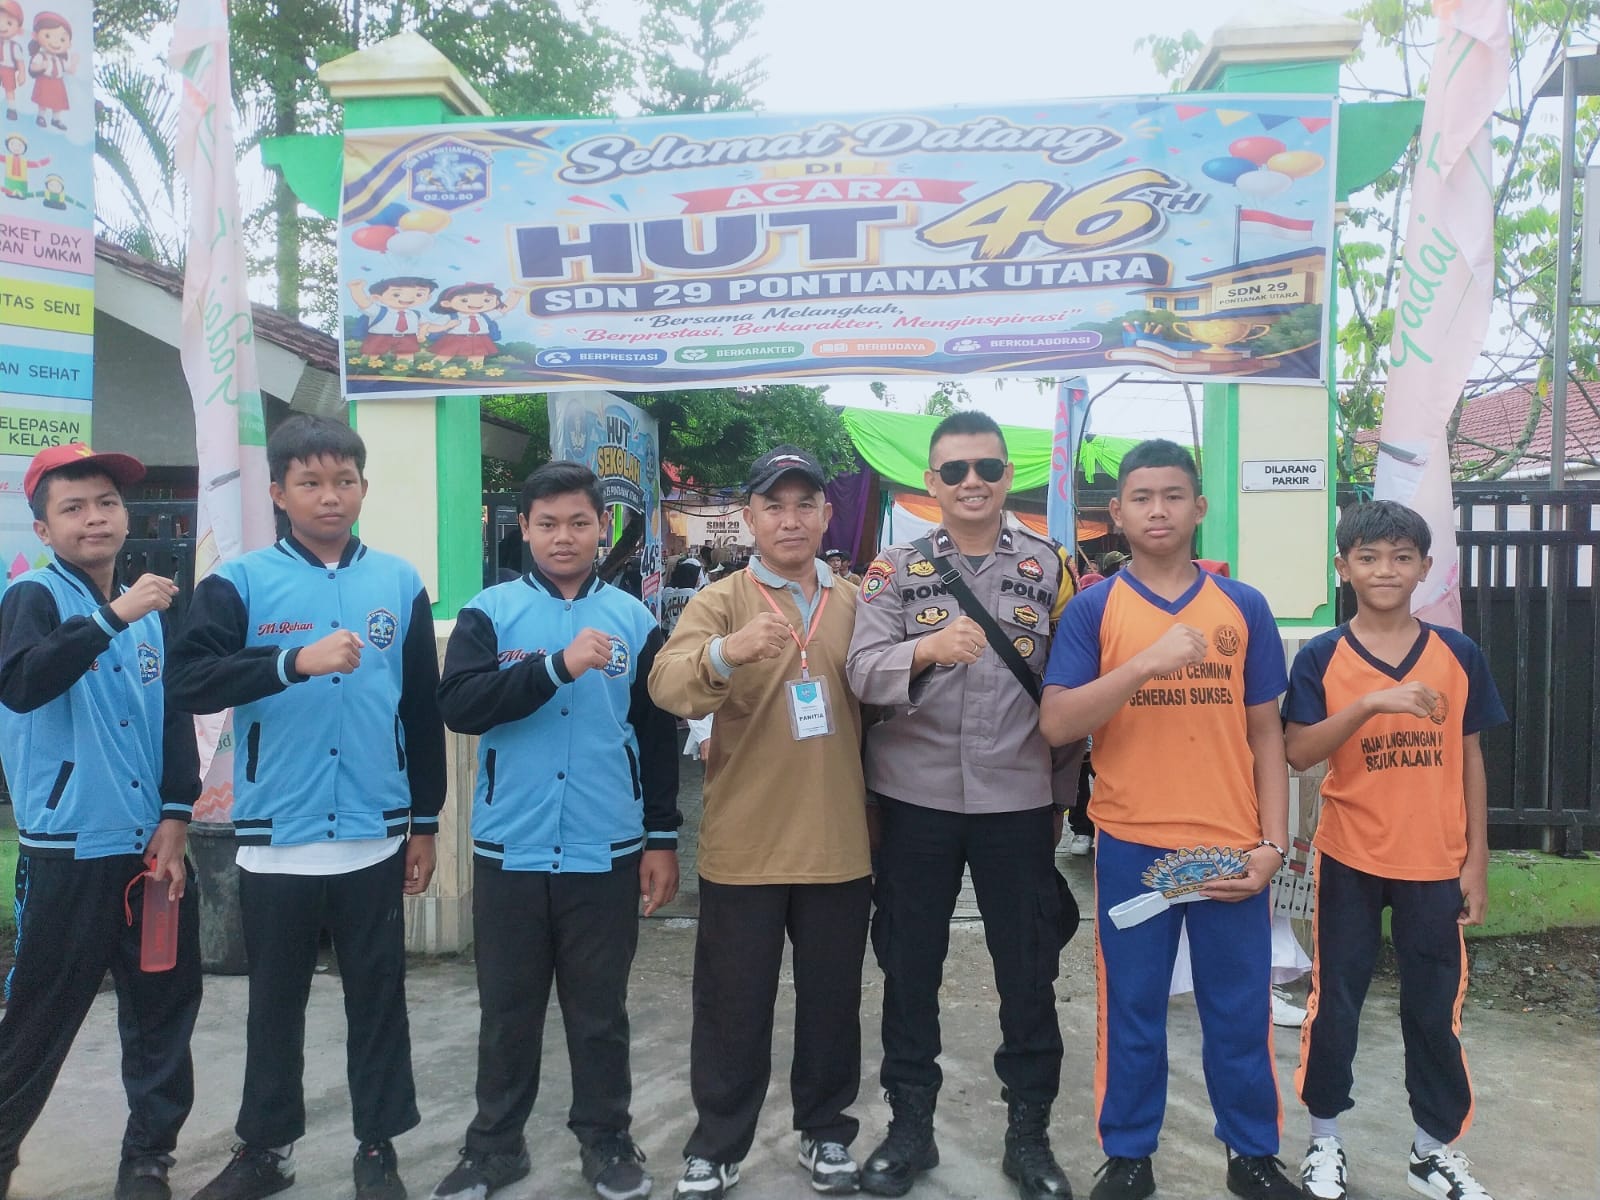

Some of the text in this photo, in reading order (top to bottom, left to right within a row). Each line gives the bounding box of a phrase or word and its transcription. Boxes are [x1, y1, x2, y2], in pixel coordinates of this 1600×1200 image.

[558, 117, 1122, 184] Selamat Datang
[805, 162, 843, 175] DI
[726, 180, 923, 208] ACARA
[50, 233, 82, 249] DAY
[515, 204, 898, 279] HUT
[0, 239, 82, 265] AN UMKM
[545, 257, 1154, 312] SDN 29 PONTIANAK UTARA
[1227, 282, 1289, 298] SDN 29
[1219, 291, 1300, 305] PONTIANAK UTARA
[43, 299, 81, 316] SENI
[762, 303, 905, 319] Melangkah,
[732, 319, 883, 337] Berkarakter,
[857, 342, 927, 352] BERBUDAYA
[990, 336, 1091, 348] BERKOLABORASI
[579, 353, 659, 362] BERPRESTASI
[716, 346, 796, 357] BERKARAKTER
[28, 364, 80, 382] SEHAT
[0, 416, 80, 434] ELEPASAN
[606, 415, 631, 449] HUT
[9, 432, 60, 447] KELAS
[1264, 465, 1317, 474] DILARANG
[1272, 476, 1310, 485] PARKIR
[1001, 579, 1054, 606] POLRI
[1190, 686, 1233, 704] SUKSES
[799, 713, 824, 721] PANITIA
[1366, 750, 1398, 772] SEJUK
